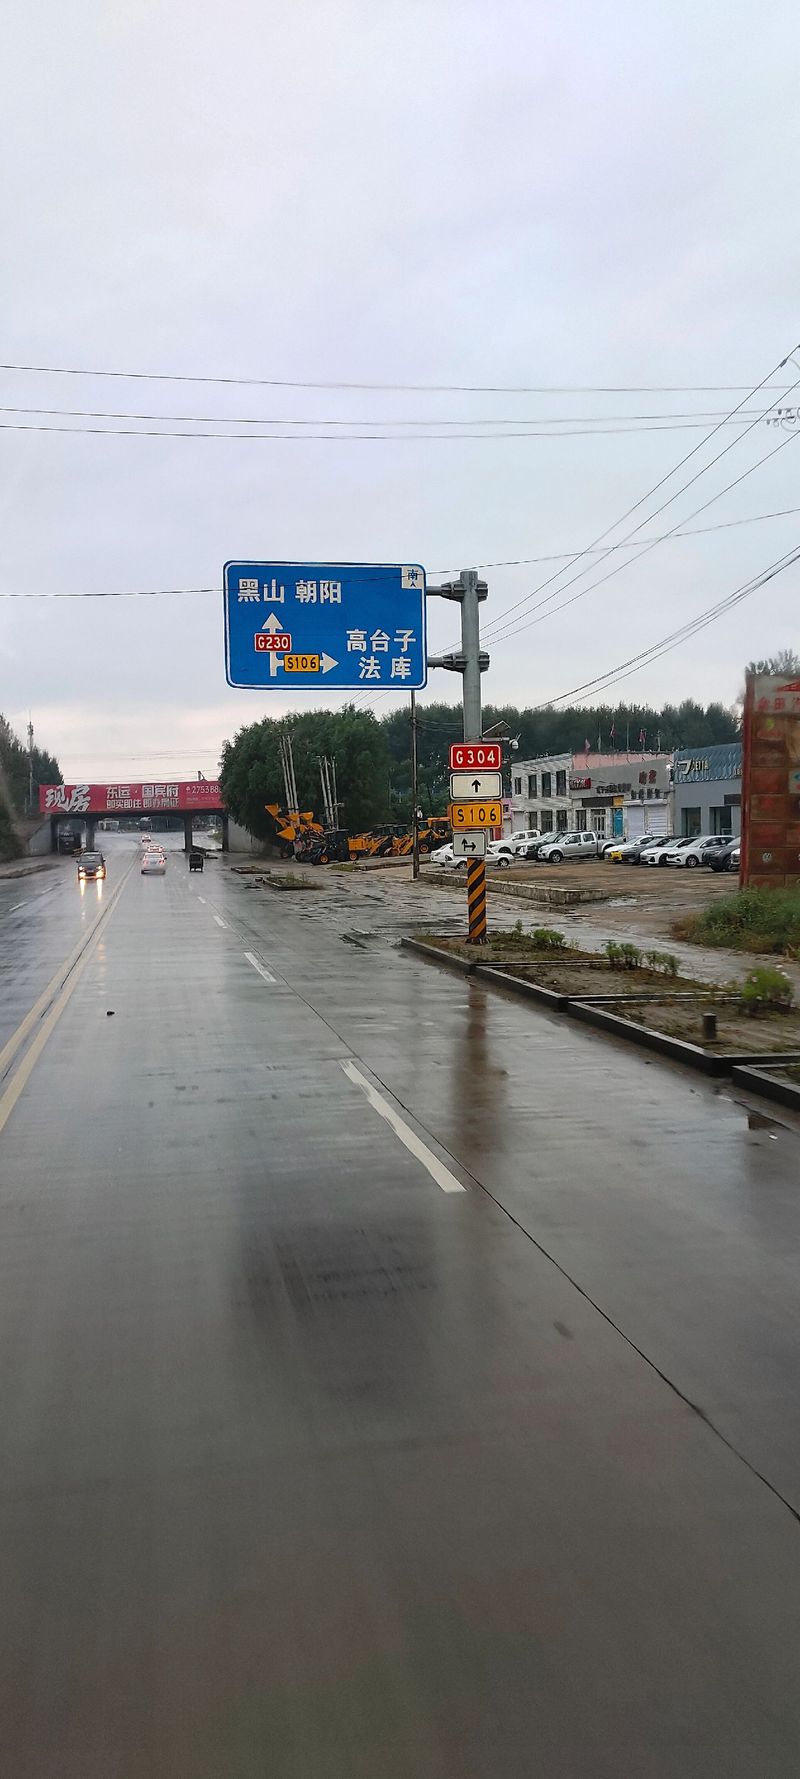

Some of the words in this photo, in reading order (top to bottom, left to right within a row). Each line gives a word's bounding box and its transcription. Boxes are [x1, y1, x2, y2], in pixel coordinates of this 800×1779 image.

[407, 569, 418, 581] 南
[238, 578, 285, 603] 黑山
[295, 579, 342, 604] 朝阳
[257, 636, 289, 649] G230
[346, 629, 416, 653] 高台子
[287, 656, 317, 669] S106
[358, 656, 412, 680] 法库
[456, 750, 495, 764] G304
[45, 784, 91, 812] 现房
[457, 807, 497, 822] S106
